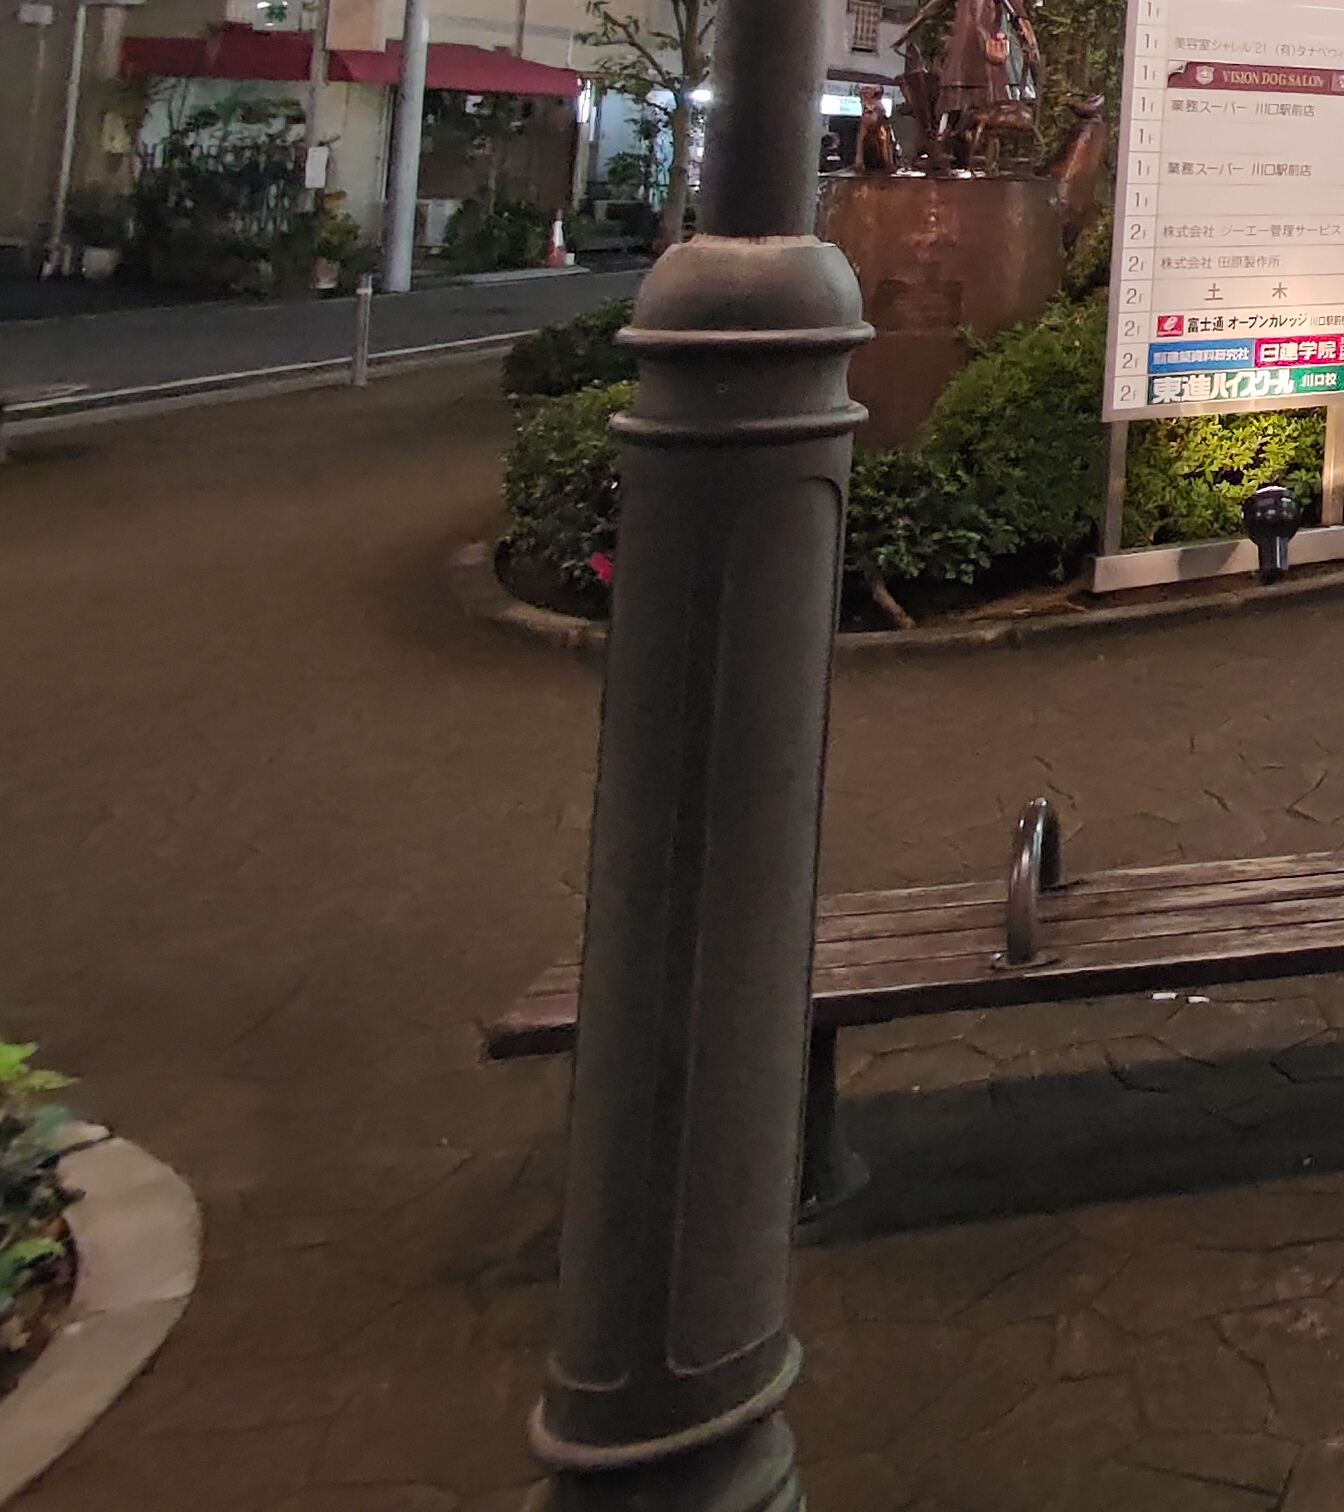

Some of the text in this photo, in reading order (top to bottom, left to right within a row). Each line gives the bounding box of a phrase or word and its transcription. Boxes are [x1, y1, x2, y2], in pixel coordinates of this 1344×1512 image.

[1223, 70, 1260, 86] VISION
[1261, 71, 1287, 86] DOG
[1287, 74, 1324, 88] SALON
[1171, 98, 1248, 114] 業務スーパー
[1255, 102, 1316, 118] 川口駅前店
[1168, 161, 1244, 176] 業務スーパー
[1251, 162, 1312, 178] 川口駅前店
[1162, 224, 1215, 239] 株式会社
[1221, 223, 1342, 239] ジーエー管理サービス
[1161, 256, 1212, 270] 株式会社
[1188, 315, 1224, 333] 富士通
[1227, 313, 1308, 329] オープンカレッジ
[1260, 340, 1336, 361] 日建学院
[1152, 369, 1295, 404] 東進ハイスクール
[1302, 372, 1338, 388] 川口校
